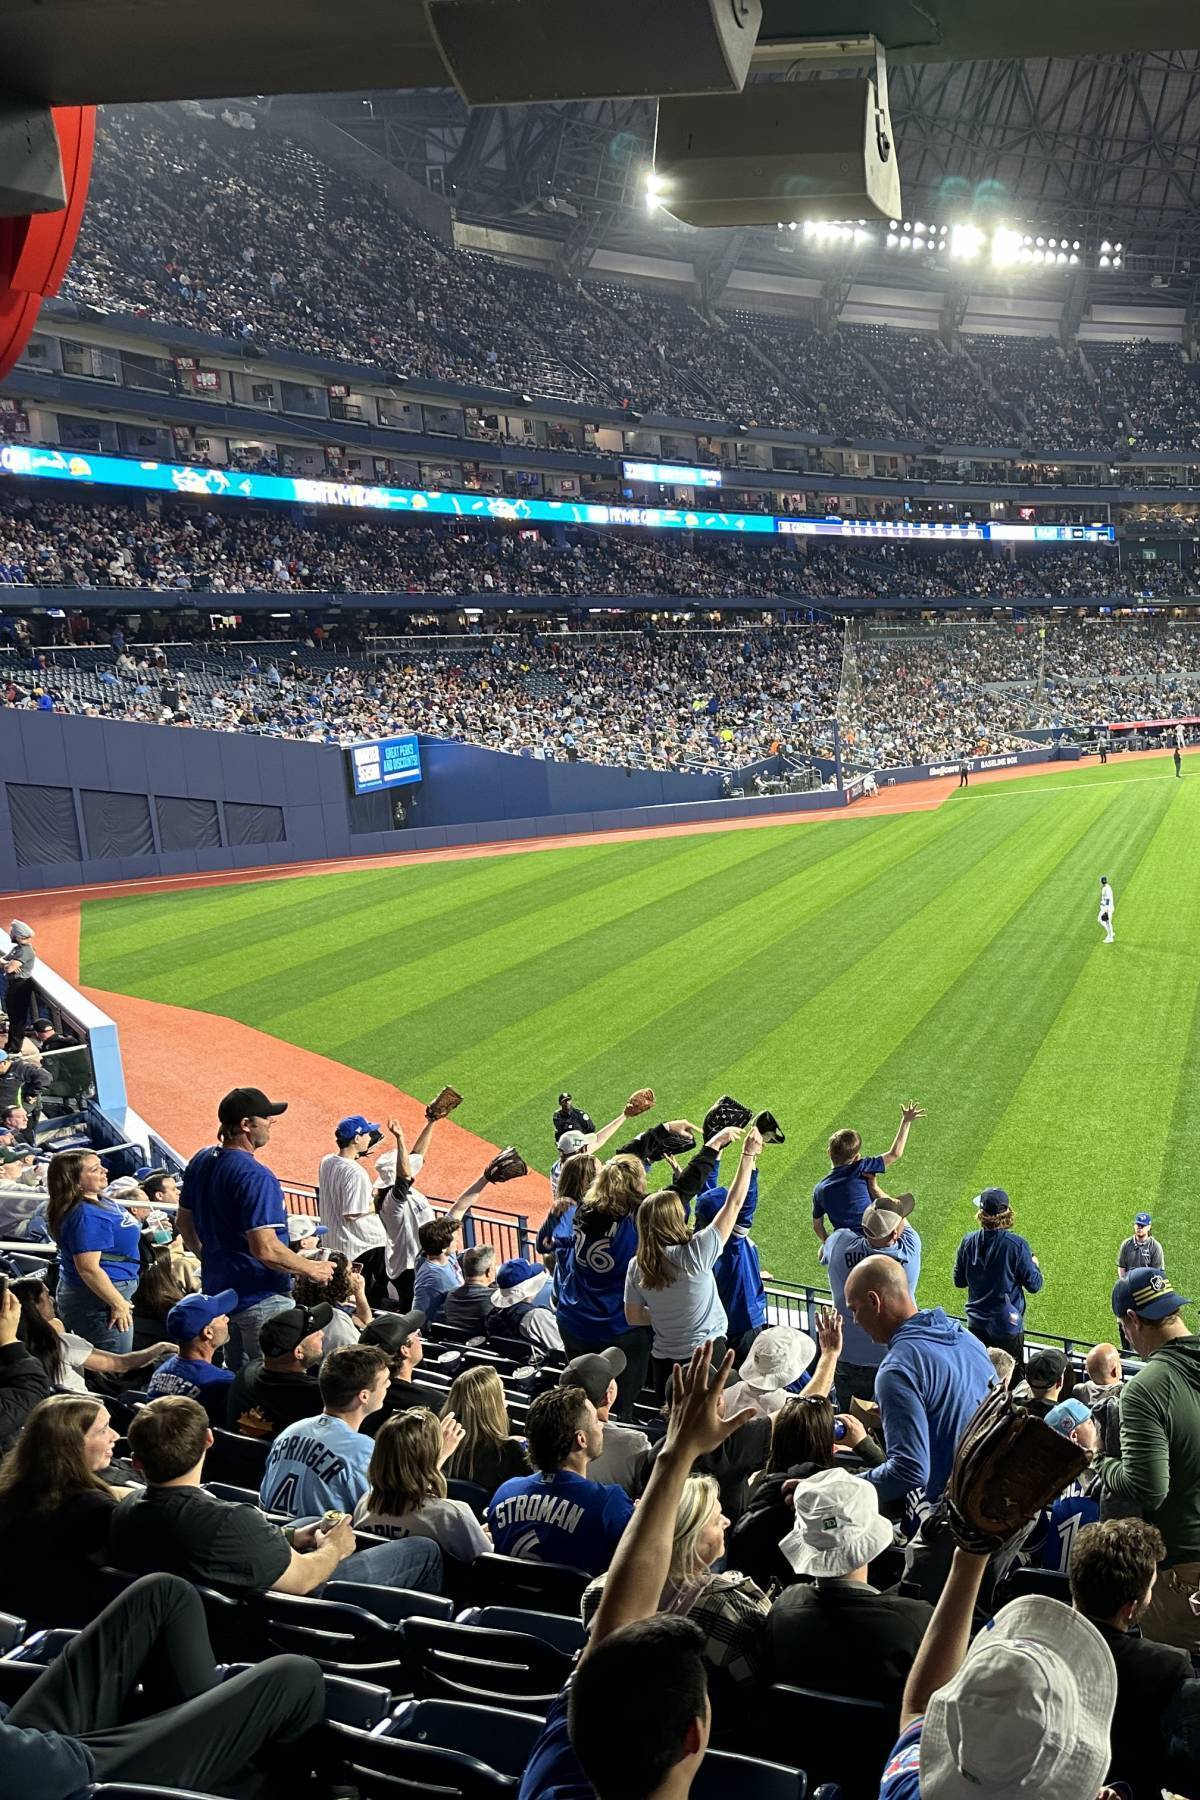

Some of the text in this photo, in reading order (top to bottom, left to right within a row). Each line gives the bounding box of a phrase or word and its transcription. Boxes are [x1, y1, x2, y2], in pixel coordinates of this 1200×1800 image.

[1144, 551, 1156, 559] TD
[980, 756, 1018, 768] BASELINE BOX
[271, 1435, 346, 1485] SPRINGER
[266, 1472, 300, 1518] 4
[495, 1494, 585, 1534] STROMAN
